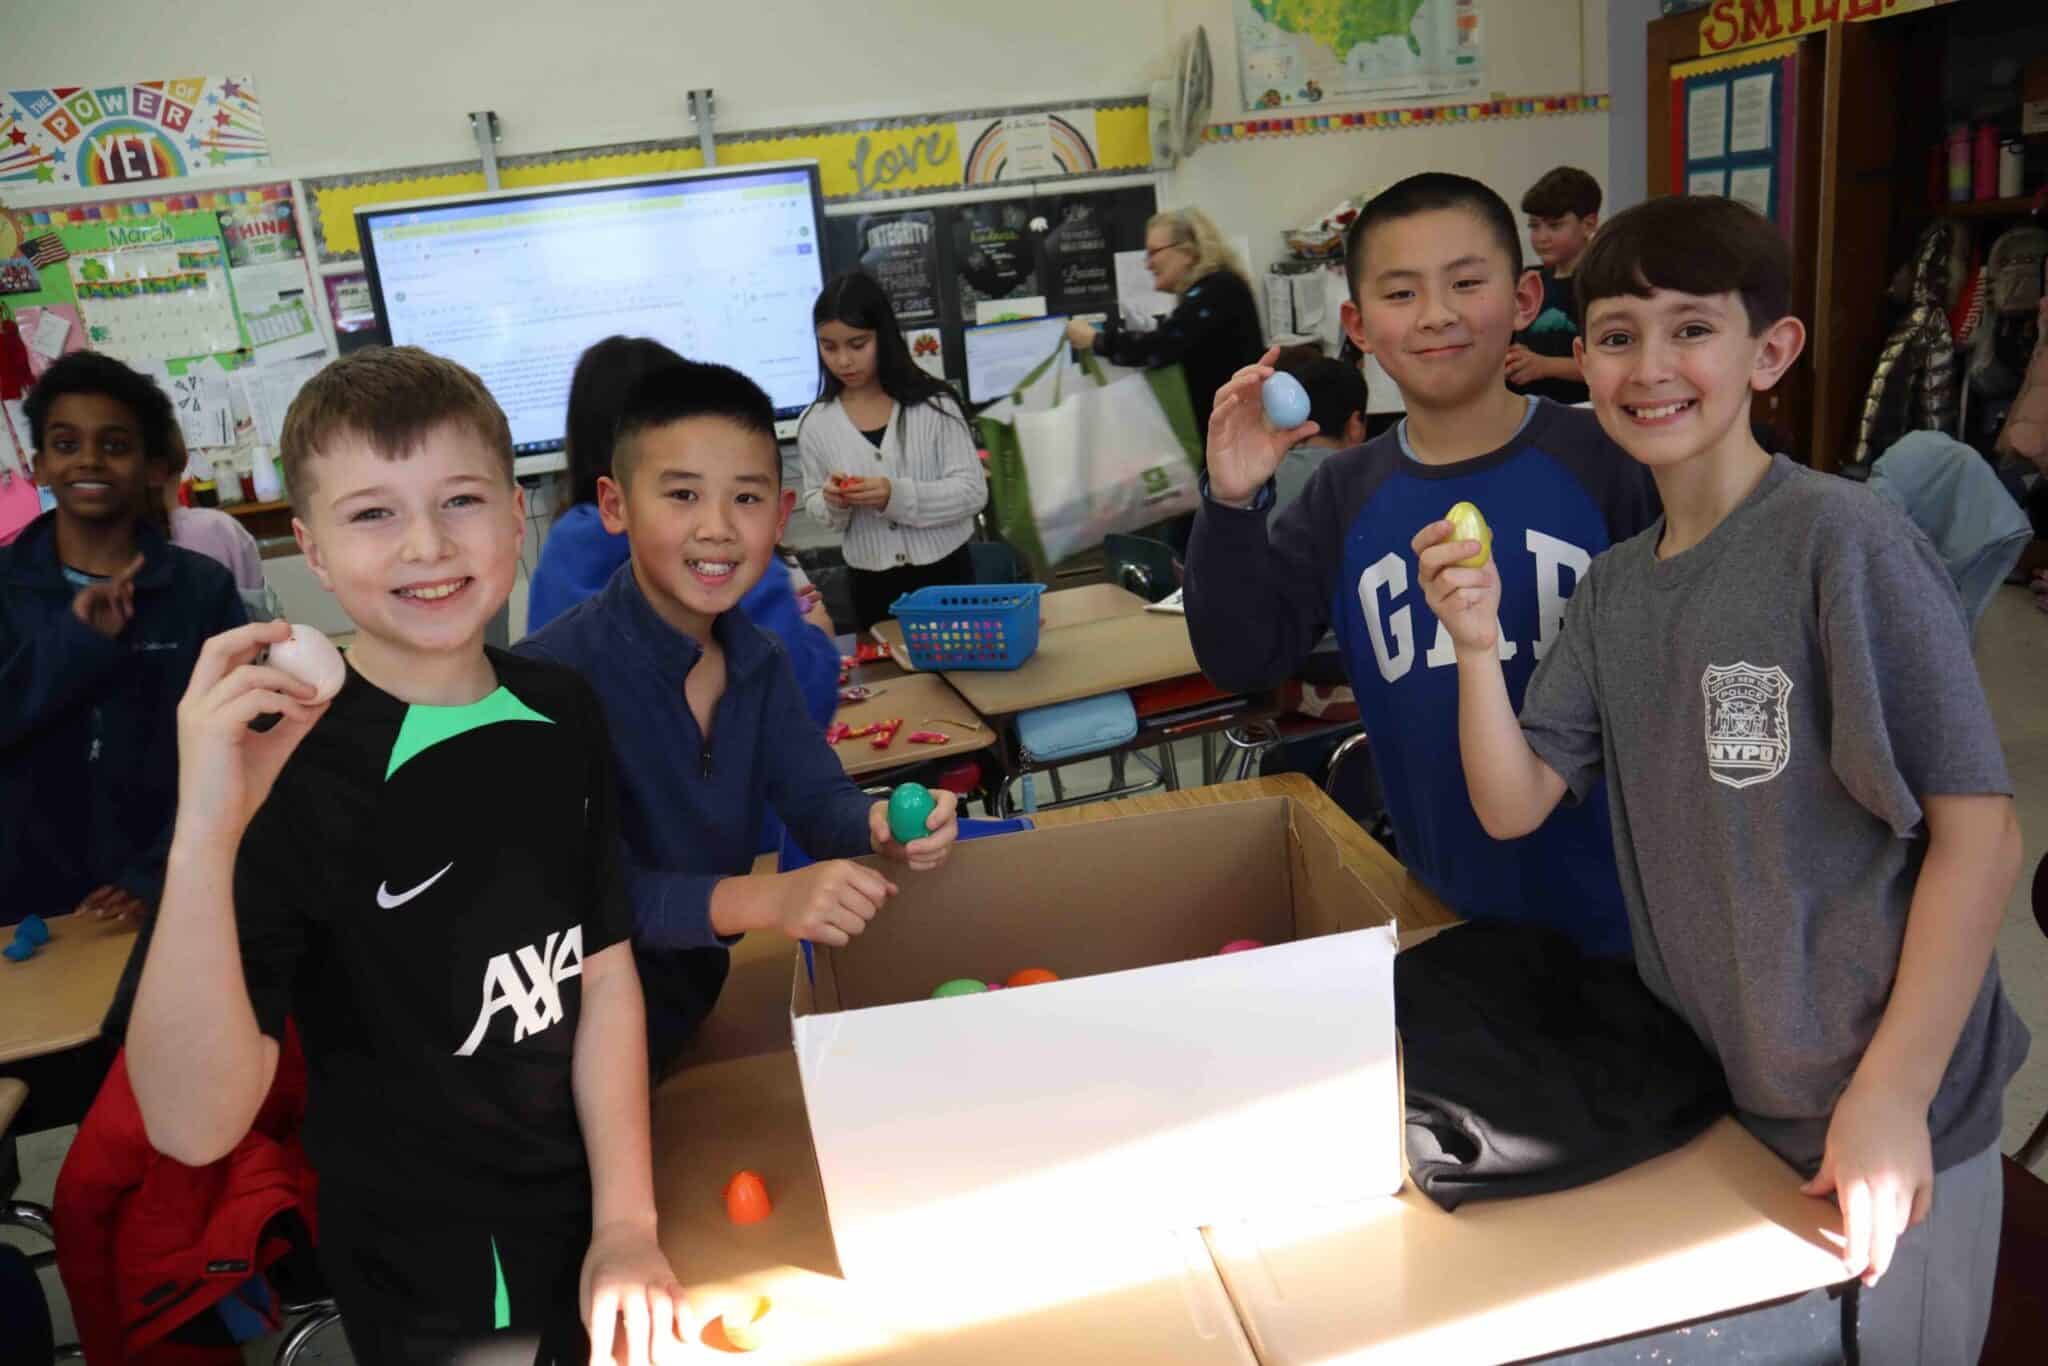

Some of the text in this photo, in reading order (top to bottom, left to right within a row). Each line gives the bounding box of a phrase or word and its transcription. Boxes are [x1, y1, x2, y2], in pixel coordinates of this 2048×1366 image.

[32, 85, 196, 137] THE POWER OF
[88, 132, 160, 181] YET
[109, 220, 173, 246] March
[1721, 688, 1763, 699] POLICE
[1711, 744, 1774, 761] NYPD
[452, 923, 583, 1056] AXA
